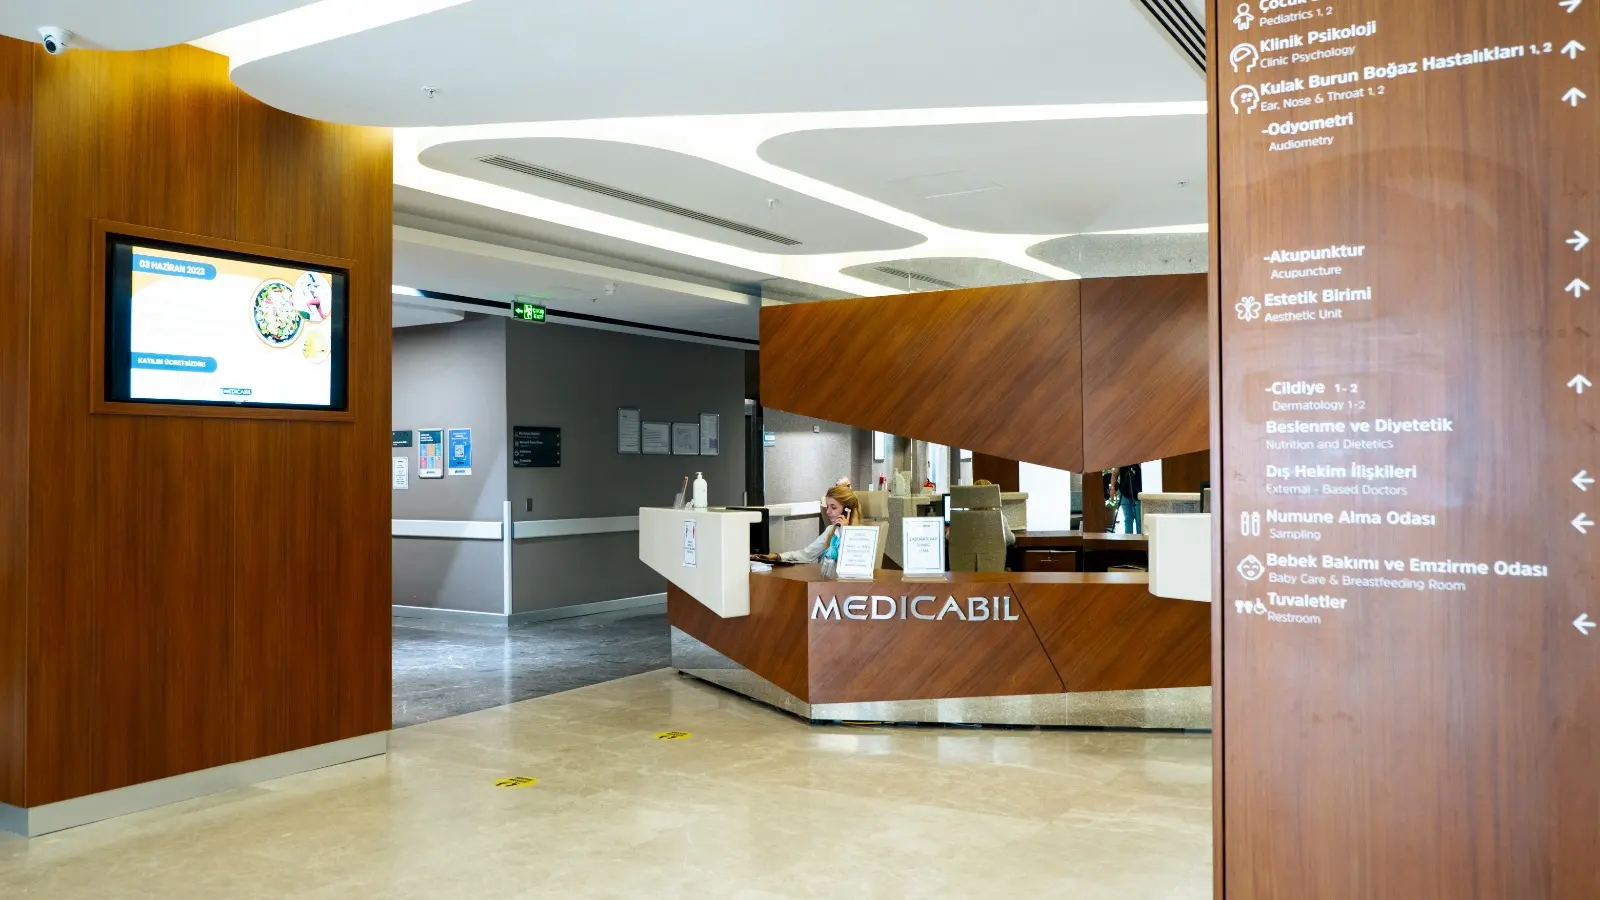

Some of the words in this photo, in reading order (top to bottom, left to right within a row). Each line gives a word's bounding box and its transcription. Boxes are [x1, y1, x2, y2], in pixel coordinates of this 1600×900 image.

[1259, 0, 1307, 13] Çocu
[1260, 10, 1313, 27] Pediatrics
[1326, 6, 1334, 16] 2
[1260, 34, 1303, 52] Klinik
[1308, 20, 1376, 45] Psikoloji
[1260, 53, 1288, 69] Clinic
[1291, 45, 1356, 63] Psychology
[1260, 78, 1304, 96] Kulak
[1308, 70, 1359, 89] Burun
[1364, 62, 1418, 81] Boğaz
[1422, 45, 1524, 71] Hastalıkları
[1542, 42, 1552, 52] 2
[1260, 99, 1280, 112] Ear,
[1283, 96, 1312, 109] Nose
[1314, 93, 1324, 104] &
[1327, 89, 1364, 102] Throat
[1378, 85, 1385, 94] 2
[1261, 112, 1353, 136] -Odyometri
[1268, 134, 1334, 152] Audiometry
[1264, 245, 1365, 263] -Akupunktur
[139, 260, 150, 268] 03
[151, 262, 185, 273] HAZİRAN
[187, 266, 206, 275] 2023
[1271, 265, 1342, 279] Acupuncture
[1264, 291, 1317, 307] Estetik
[1323, 287, 1372, 303] Birimi
[1264, 312, 1315, 322] Aesthetic
[1319, 309, 1342, 319] Unit
[1265, 382, 1325, 396] -Cildiye
[1273, 400, 1344, 411] Dermatology
[1348, 401, 1366, 409] 1-2
[1266, 420, 1345, 434] Beslenme
[1351, 422, 1369, 432] ve
[1375, 418, 1452, 434] Diyetetik
[1266, 439, 1313, 450] Nutrition
[1317, 439, 1339, 449] and
[1343, 438, 1394, 449] Dietetics
[1266, 465, 1291, 481] Dış
[1294, 465, 1346, 478] Hekim
[1351, 462, 1417, 480] İlişkileri
[1266, 484, 1311, 495] External
[1322, 484, 1359, 495] Based
[1363, 484, 1408, 496] Doctors
[1266, 510, 1333, 524] Numune
[1338, 510, 1381, 525] Alma
[1386, 511, 1436, 526] Odası
[1269, 528, 1321, 541] Sampling
[1266, 554, 1317, 569] Bebek
[1322, 554, 1379, 571] Bakımı
[1384, 559, 1404, 572] ve
[1409, 558, 1489, 575] Emzirme
[1494, 561, 1548, 578] Odası
[1268, 572, 1298, 585] Baby
[1301, 573, 1326, 585] Care
[1329, 574, 1339, 586] &
[1342, 574, 1425, 591] Breastfeeding
[1429, 578, 1466, 592] Room
[811, 595, 1020, 621] MEDICABIL
[1267, 592, 1347, 609] Tuvaletler
[1268, 612, 1321, 624] Restroom
